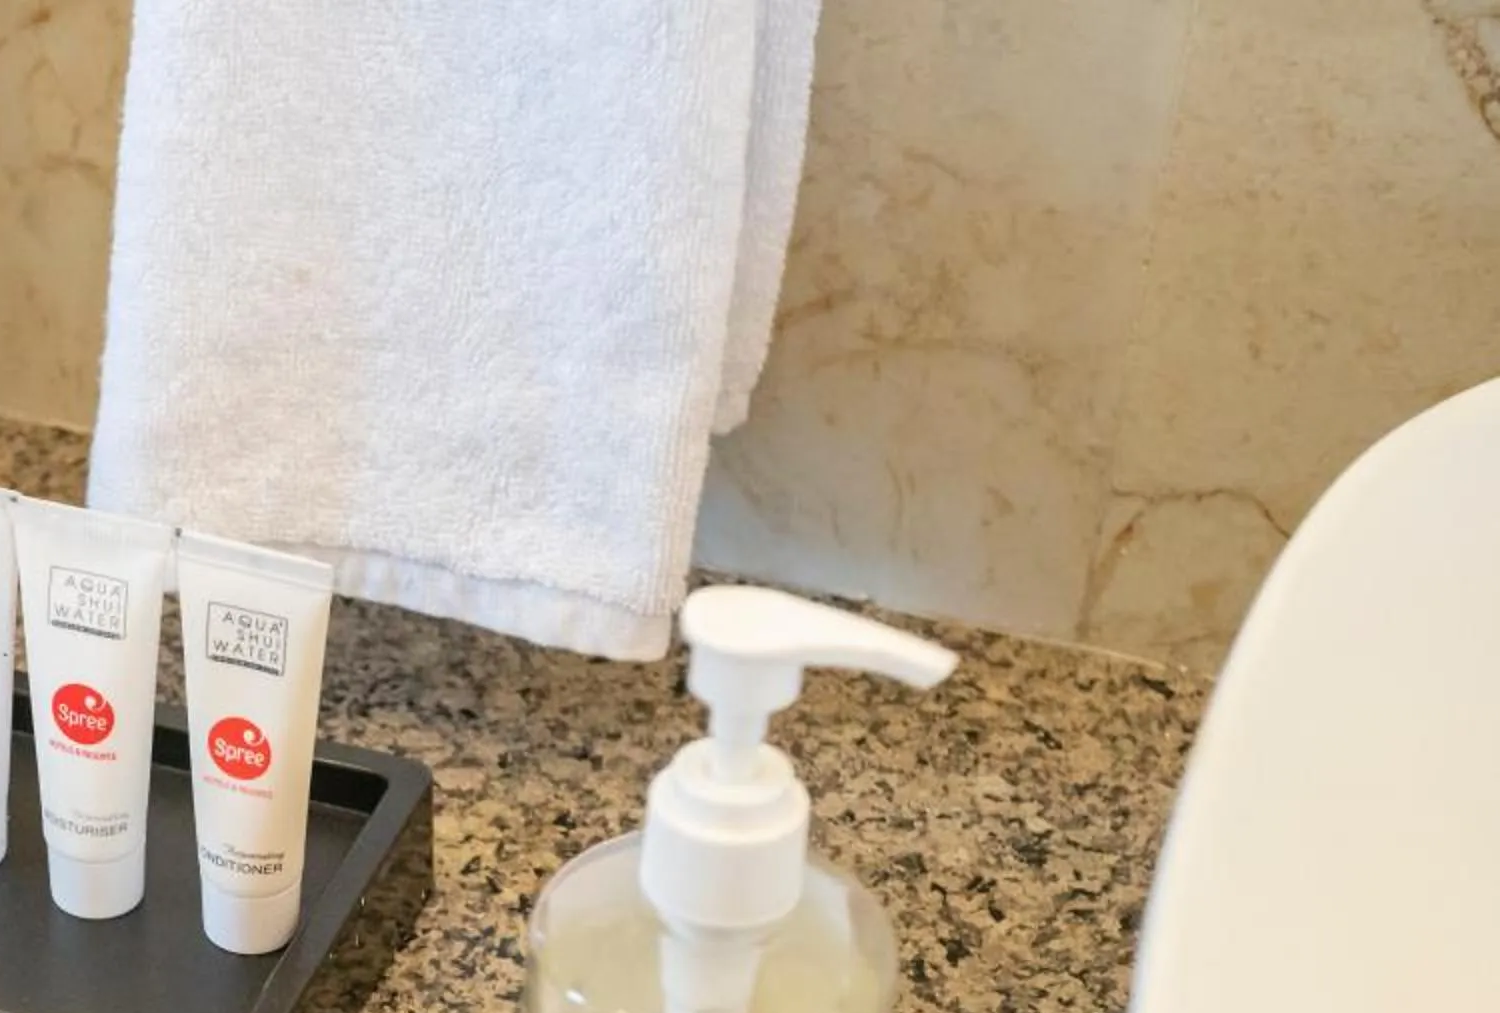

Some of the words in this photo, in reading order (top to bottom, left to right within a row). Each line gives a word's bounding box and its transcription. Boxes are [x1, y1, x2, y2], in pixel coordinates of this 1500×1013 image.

[64, 575, 121, 597] AQUA
[53, 602, 121, 630] WATER
[78, 592, 121, 615] SHUI
[222, 611, 281, 635] AQUA
[236, 628, 280, 650] SHUI
[212, 639, 279, 665] WATER
[58, 703, 107, 731] Spree
[214, 737, 265, 768] Spree
